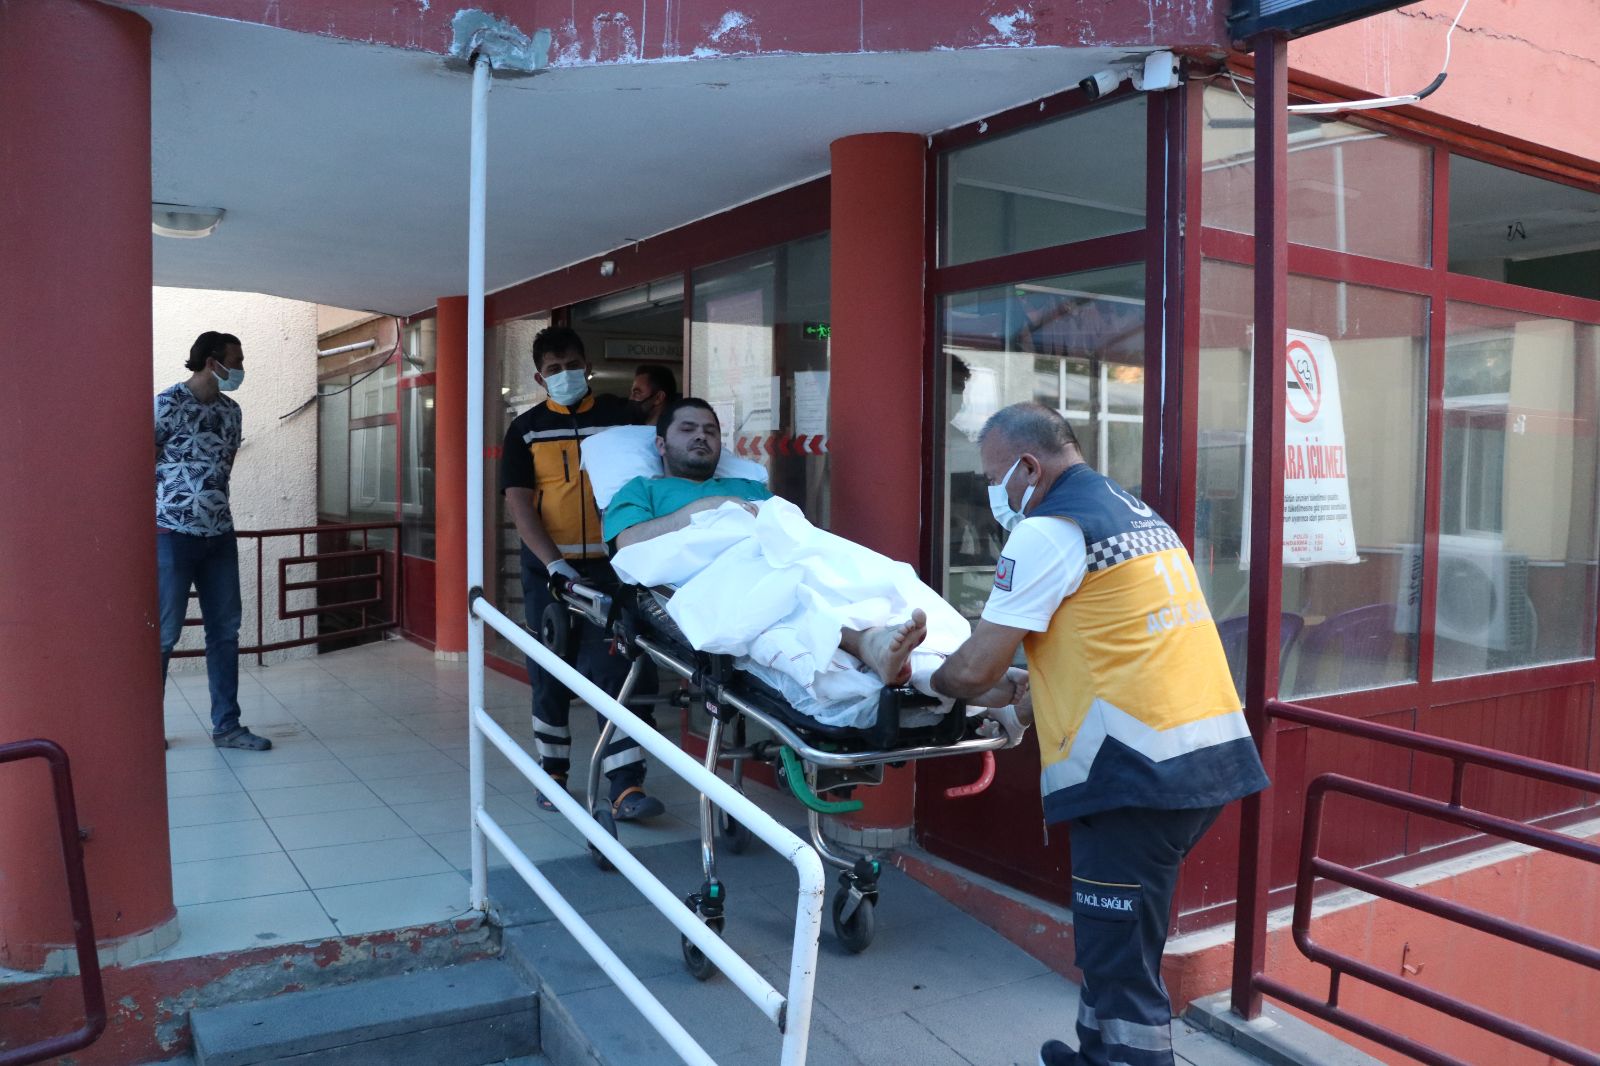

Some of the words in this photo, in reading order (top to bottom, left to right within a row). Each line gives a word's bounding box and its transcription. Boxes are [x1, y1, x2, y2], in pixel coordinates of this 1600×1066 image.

[1306, 436, 1345, 484] İÇİLMEZ
[1147, 599, 1187, 635] ACİL
[1084, 893, 1100, 907] ACİL
[1101, 896, 1133, 911] SAĞLIK
